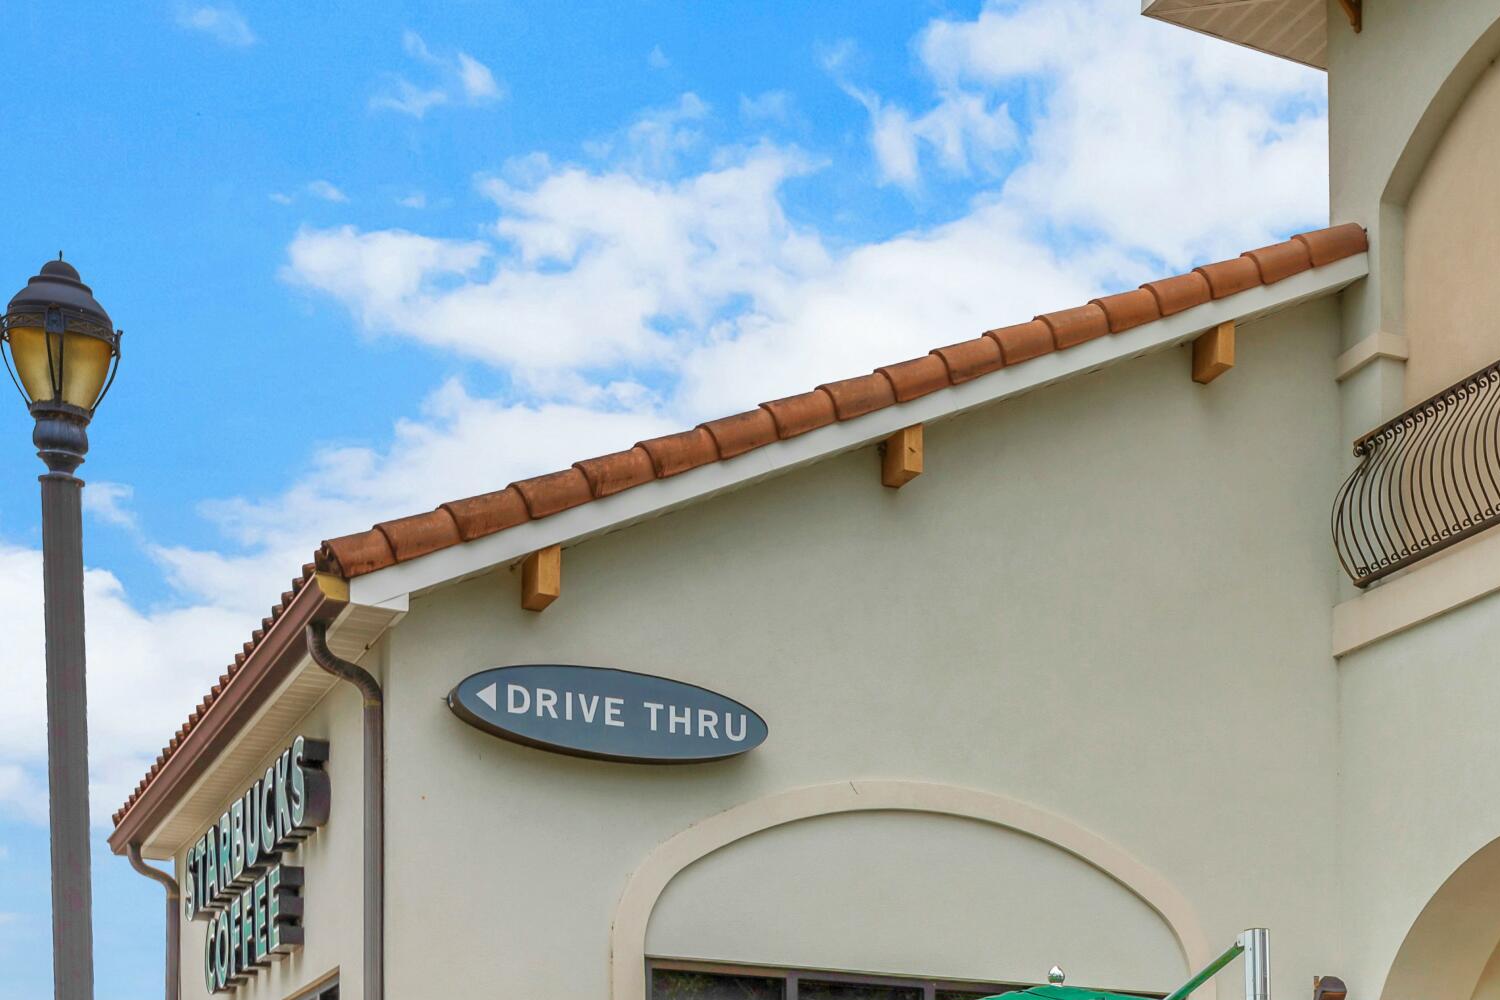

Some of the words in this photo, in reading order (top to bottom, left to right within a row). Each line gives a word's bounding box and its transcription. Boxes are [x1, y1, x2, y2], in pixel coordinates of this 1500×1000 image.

[506, 683, 625, 727] DRIVE
[642, 701, 748, 742] THRU
[184, 735, 305, 922] STARBUCKS
[204, 863, 281, 995] COFFEE
